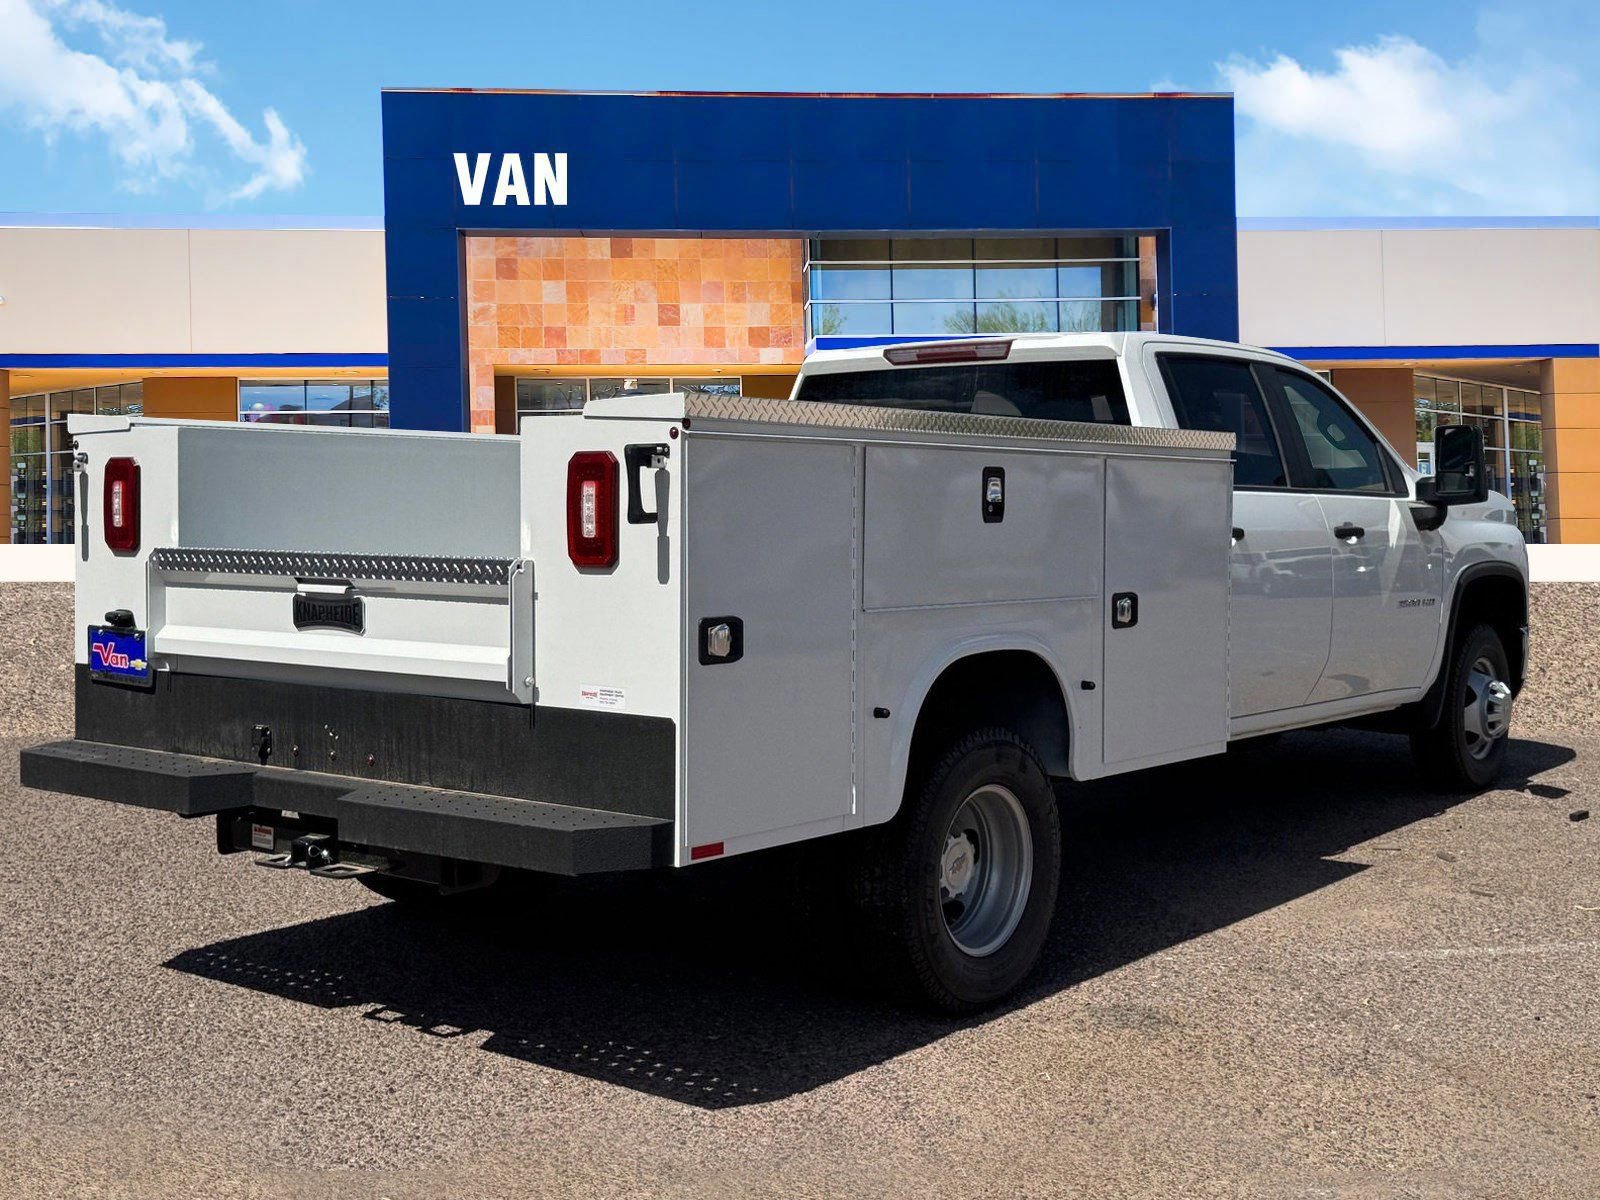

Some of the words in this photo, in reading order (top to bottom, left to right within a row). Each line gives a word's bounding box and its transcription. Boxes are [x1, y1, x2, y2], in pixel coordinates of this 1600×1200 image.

[453, 153, 568, 205] VAN
[295, 600, 360, 625] KNAPHEIDE
[92, 642, 129, 669] Van
